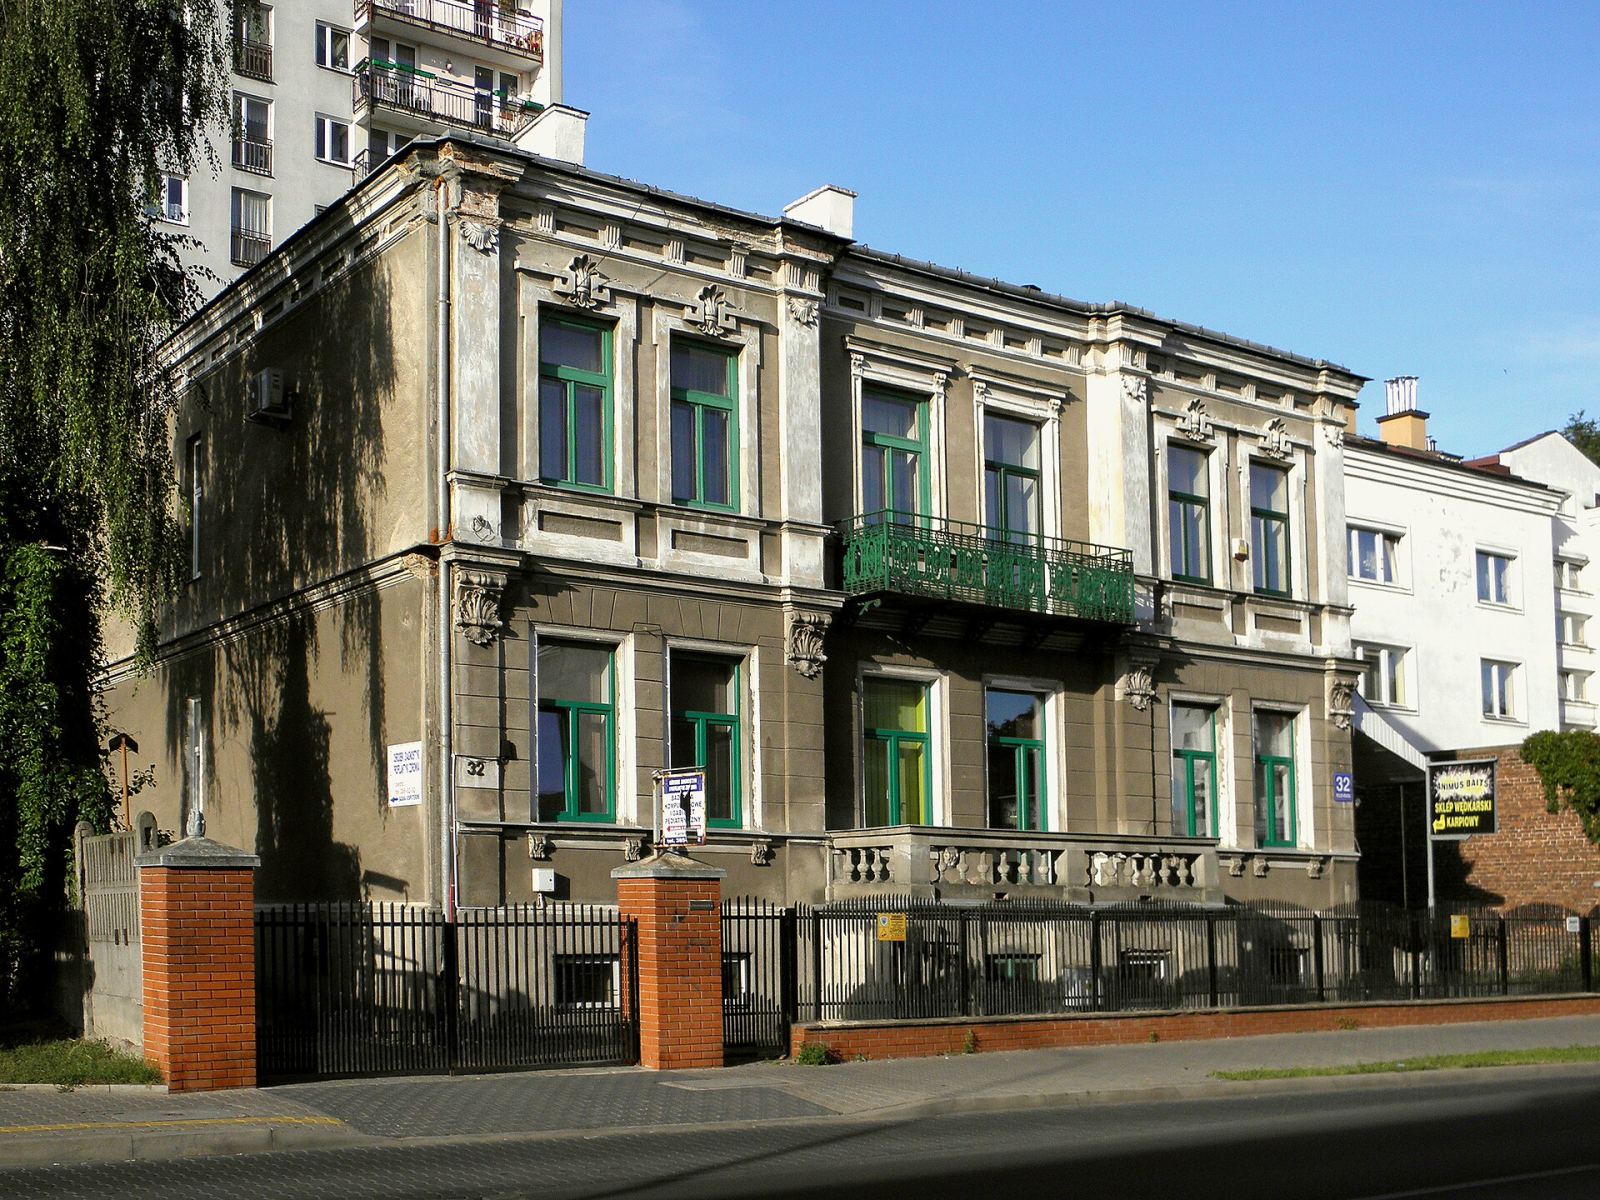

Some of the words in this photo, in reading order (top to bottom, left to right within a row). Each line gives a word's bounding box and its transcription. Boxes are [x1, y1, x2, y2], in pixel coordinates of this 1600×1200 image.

[467, 761, 485, 776] 32
[1336, 776, 1350, 792] 32
[1437, 781, 1464, 791] ANIMUS
[1466, 778, 1489, 788] BAITS
[1435, 801, 1453, 813] SKLEP
[1454, 800, 1492, 815] WĘDKARSKI
[1446, 815, 1479, 828] KARPIOWY
